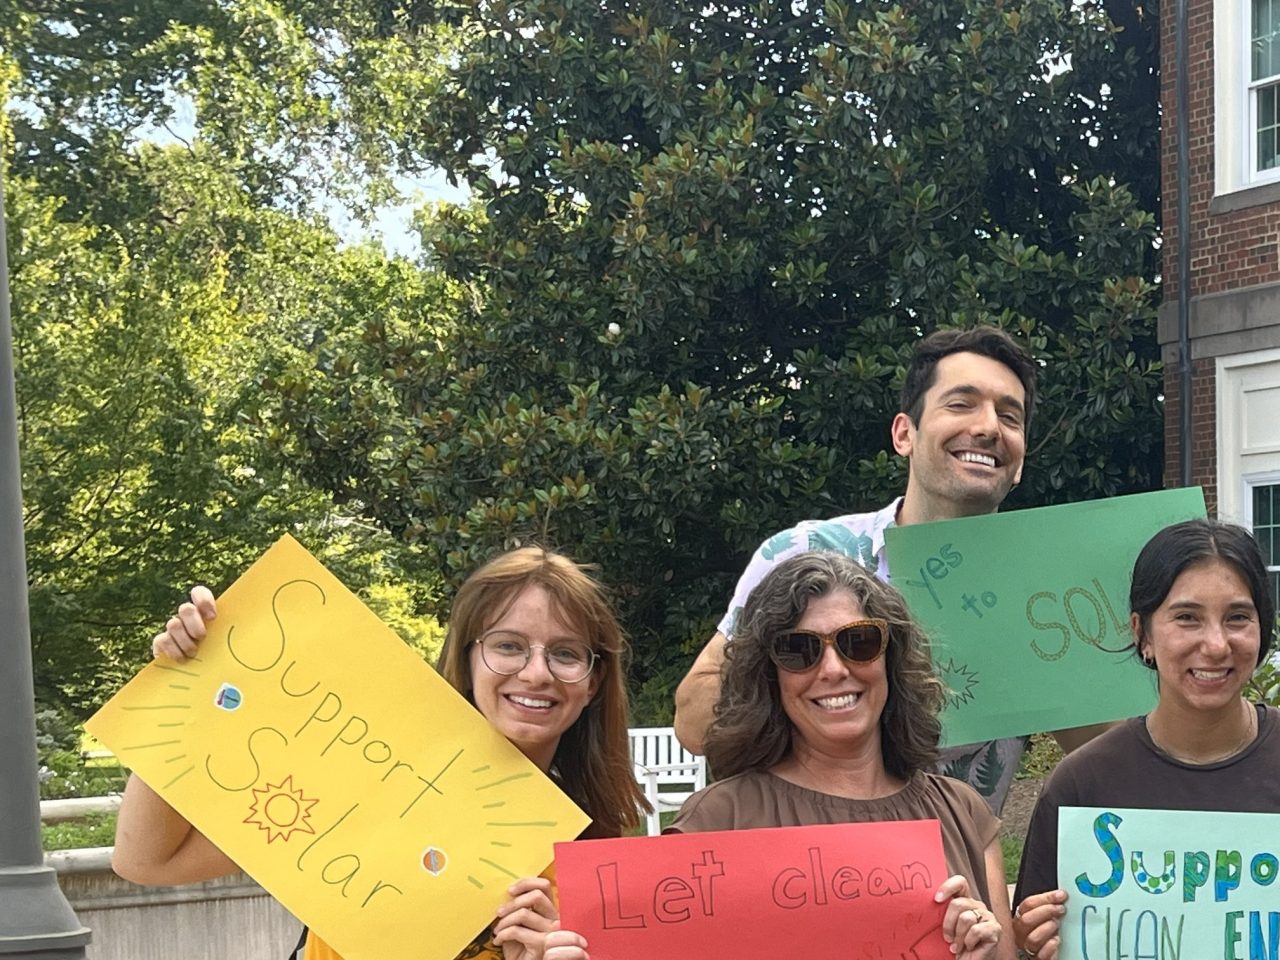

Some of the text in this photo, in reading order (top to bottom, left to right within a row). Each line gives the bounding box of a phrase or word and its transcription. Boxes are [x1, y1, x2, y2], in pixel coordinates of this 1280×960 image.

[961, 590, 998, 619] to
[1025, 577, 1132, 662] SOL
[227, 579, 464, 818] Support
[205, 726, 404, 909] Solar
[595, 846, 933, 931] Let clean
